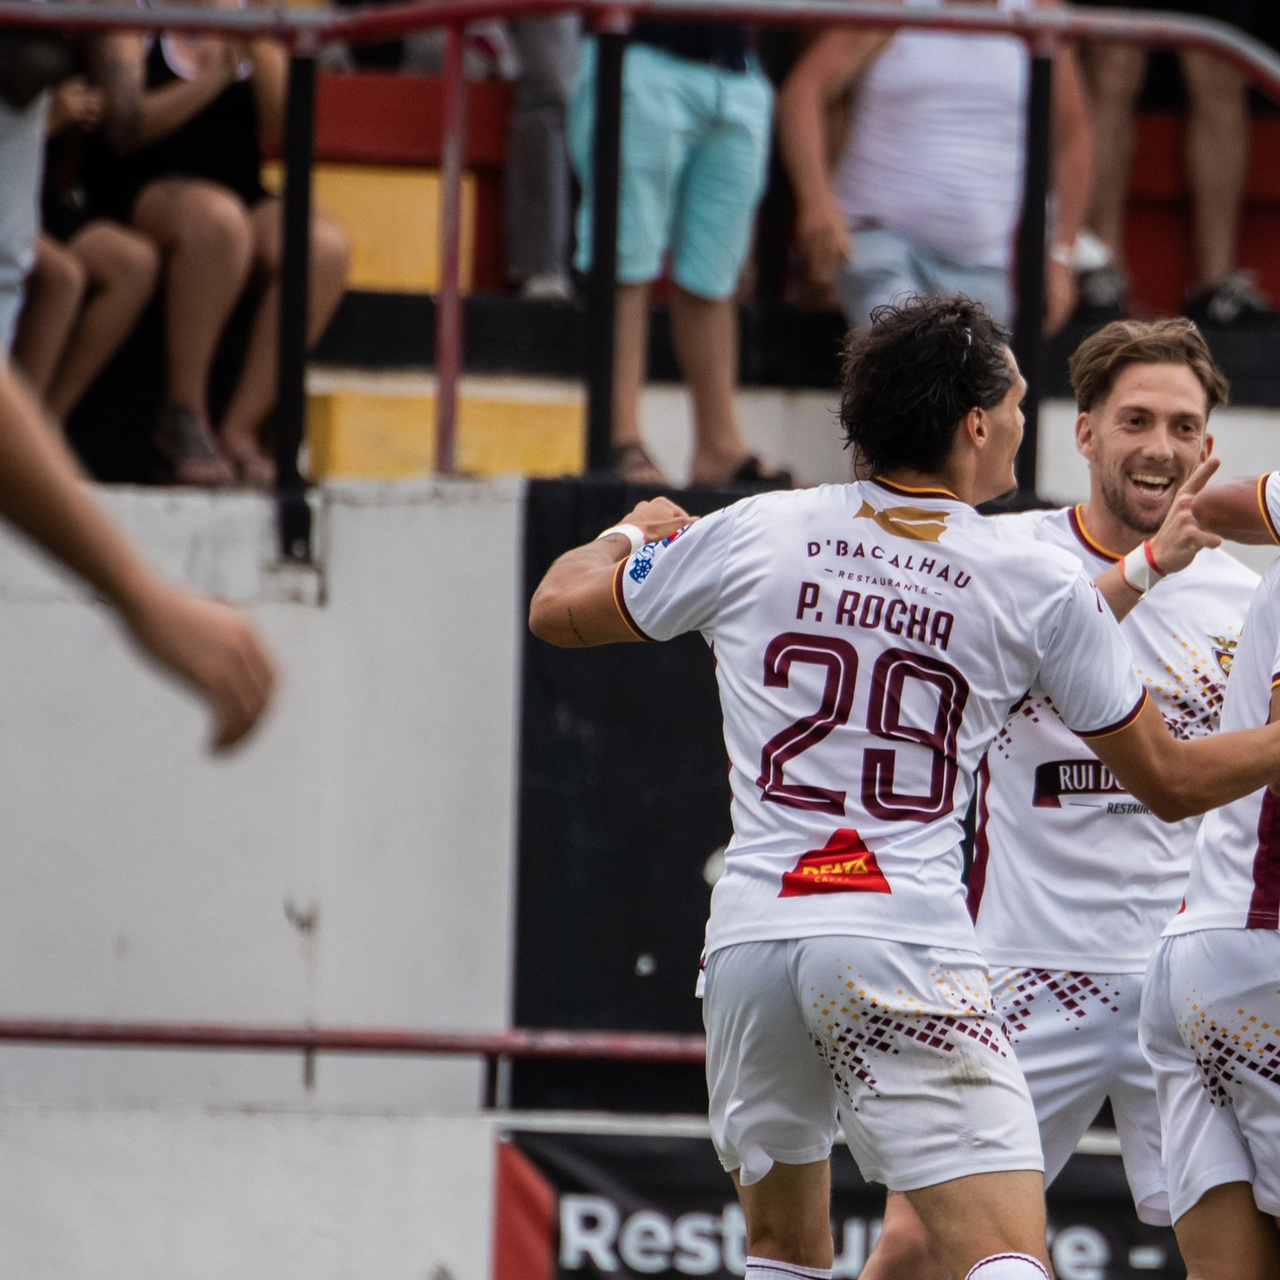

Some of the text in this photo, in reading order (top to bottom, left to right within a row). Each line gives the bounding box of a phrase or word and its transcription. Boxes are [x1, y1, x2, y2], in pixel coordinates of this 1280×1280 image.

[807, 539, 971, 589] D'BACALHAU
[838, 571, 928, 595] RESTAURANTE
[796, 582, 954, 651] P. ROCHA
[756, 631, 970, 823] 29
[1059, 765, 1093, 790] RUI
[1107, 802, 1152, 815] RESTAUR
